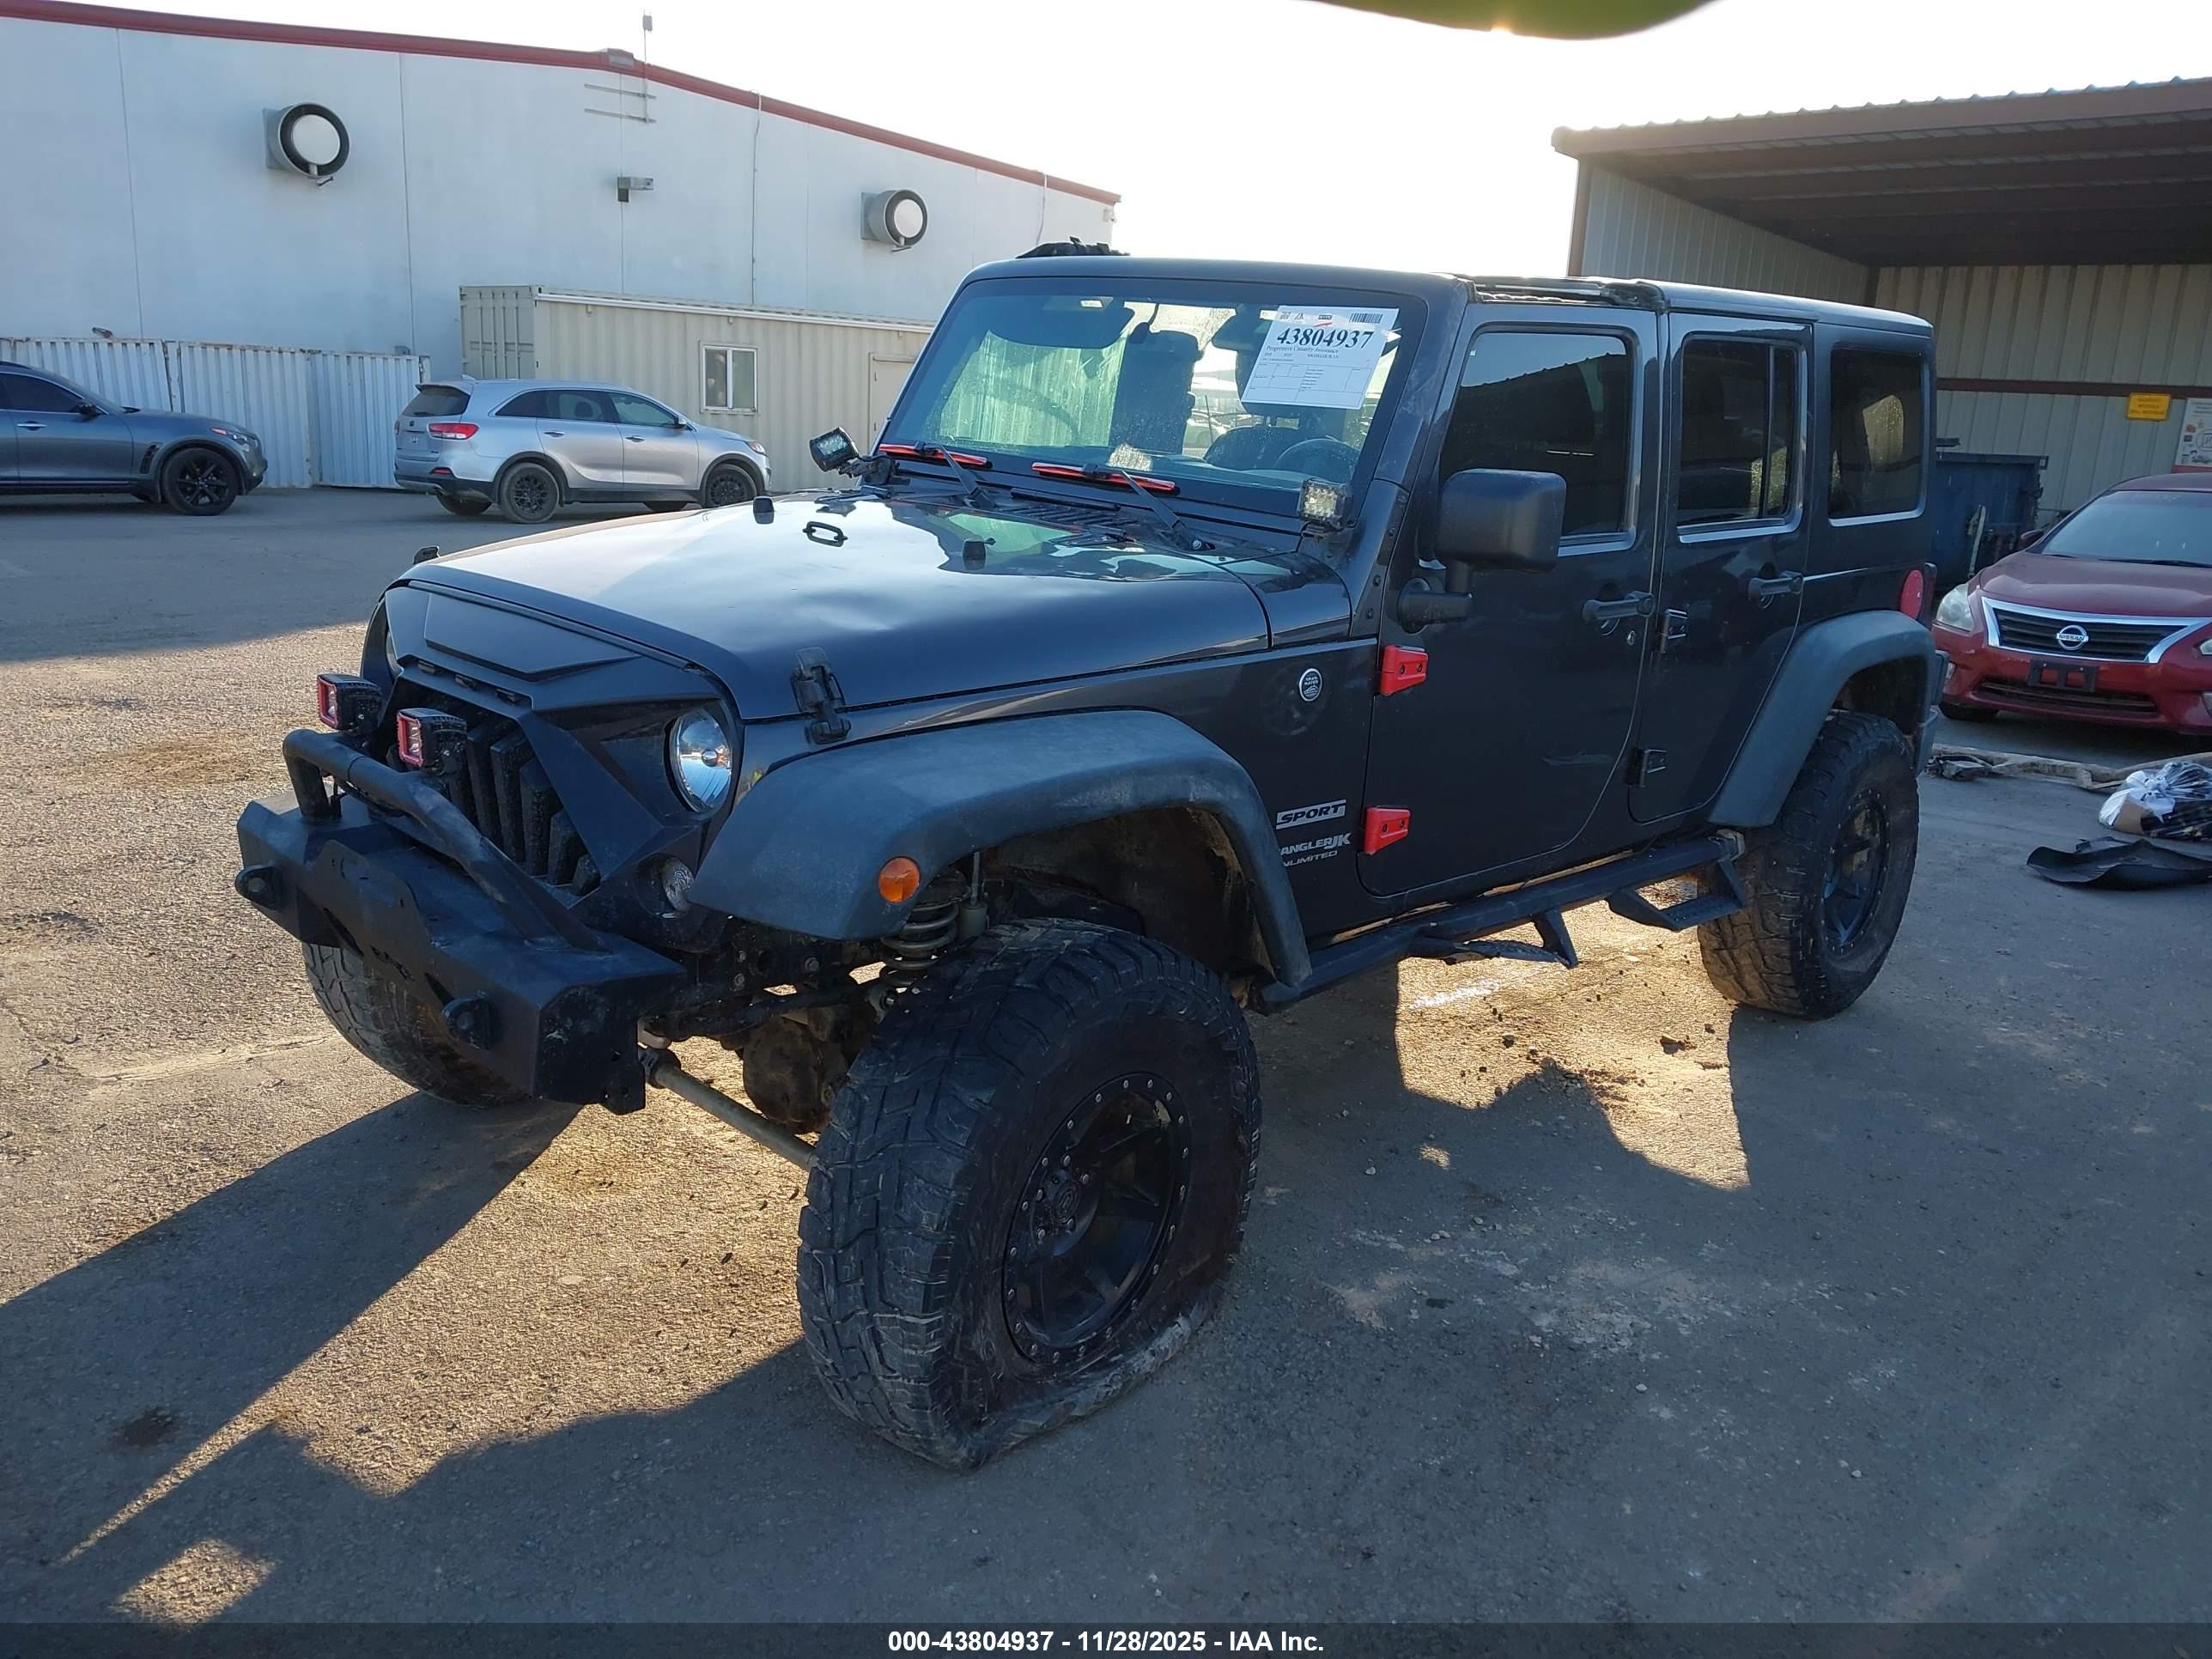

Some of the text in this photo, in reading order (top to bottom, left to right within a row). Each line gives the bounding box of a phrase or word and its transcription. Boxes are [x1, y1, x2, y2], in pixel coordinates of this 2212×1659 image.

[1277, 327, 1374, 349] 43804937
[1281, 805, 1340, 823] SPORT
[1279, 838, 1333, 856] ANGLER
